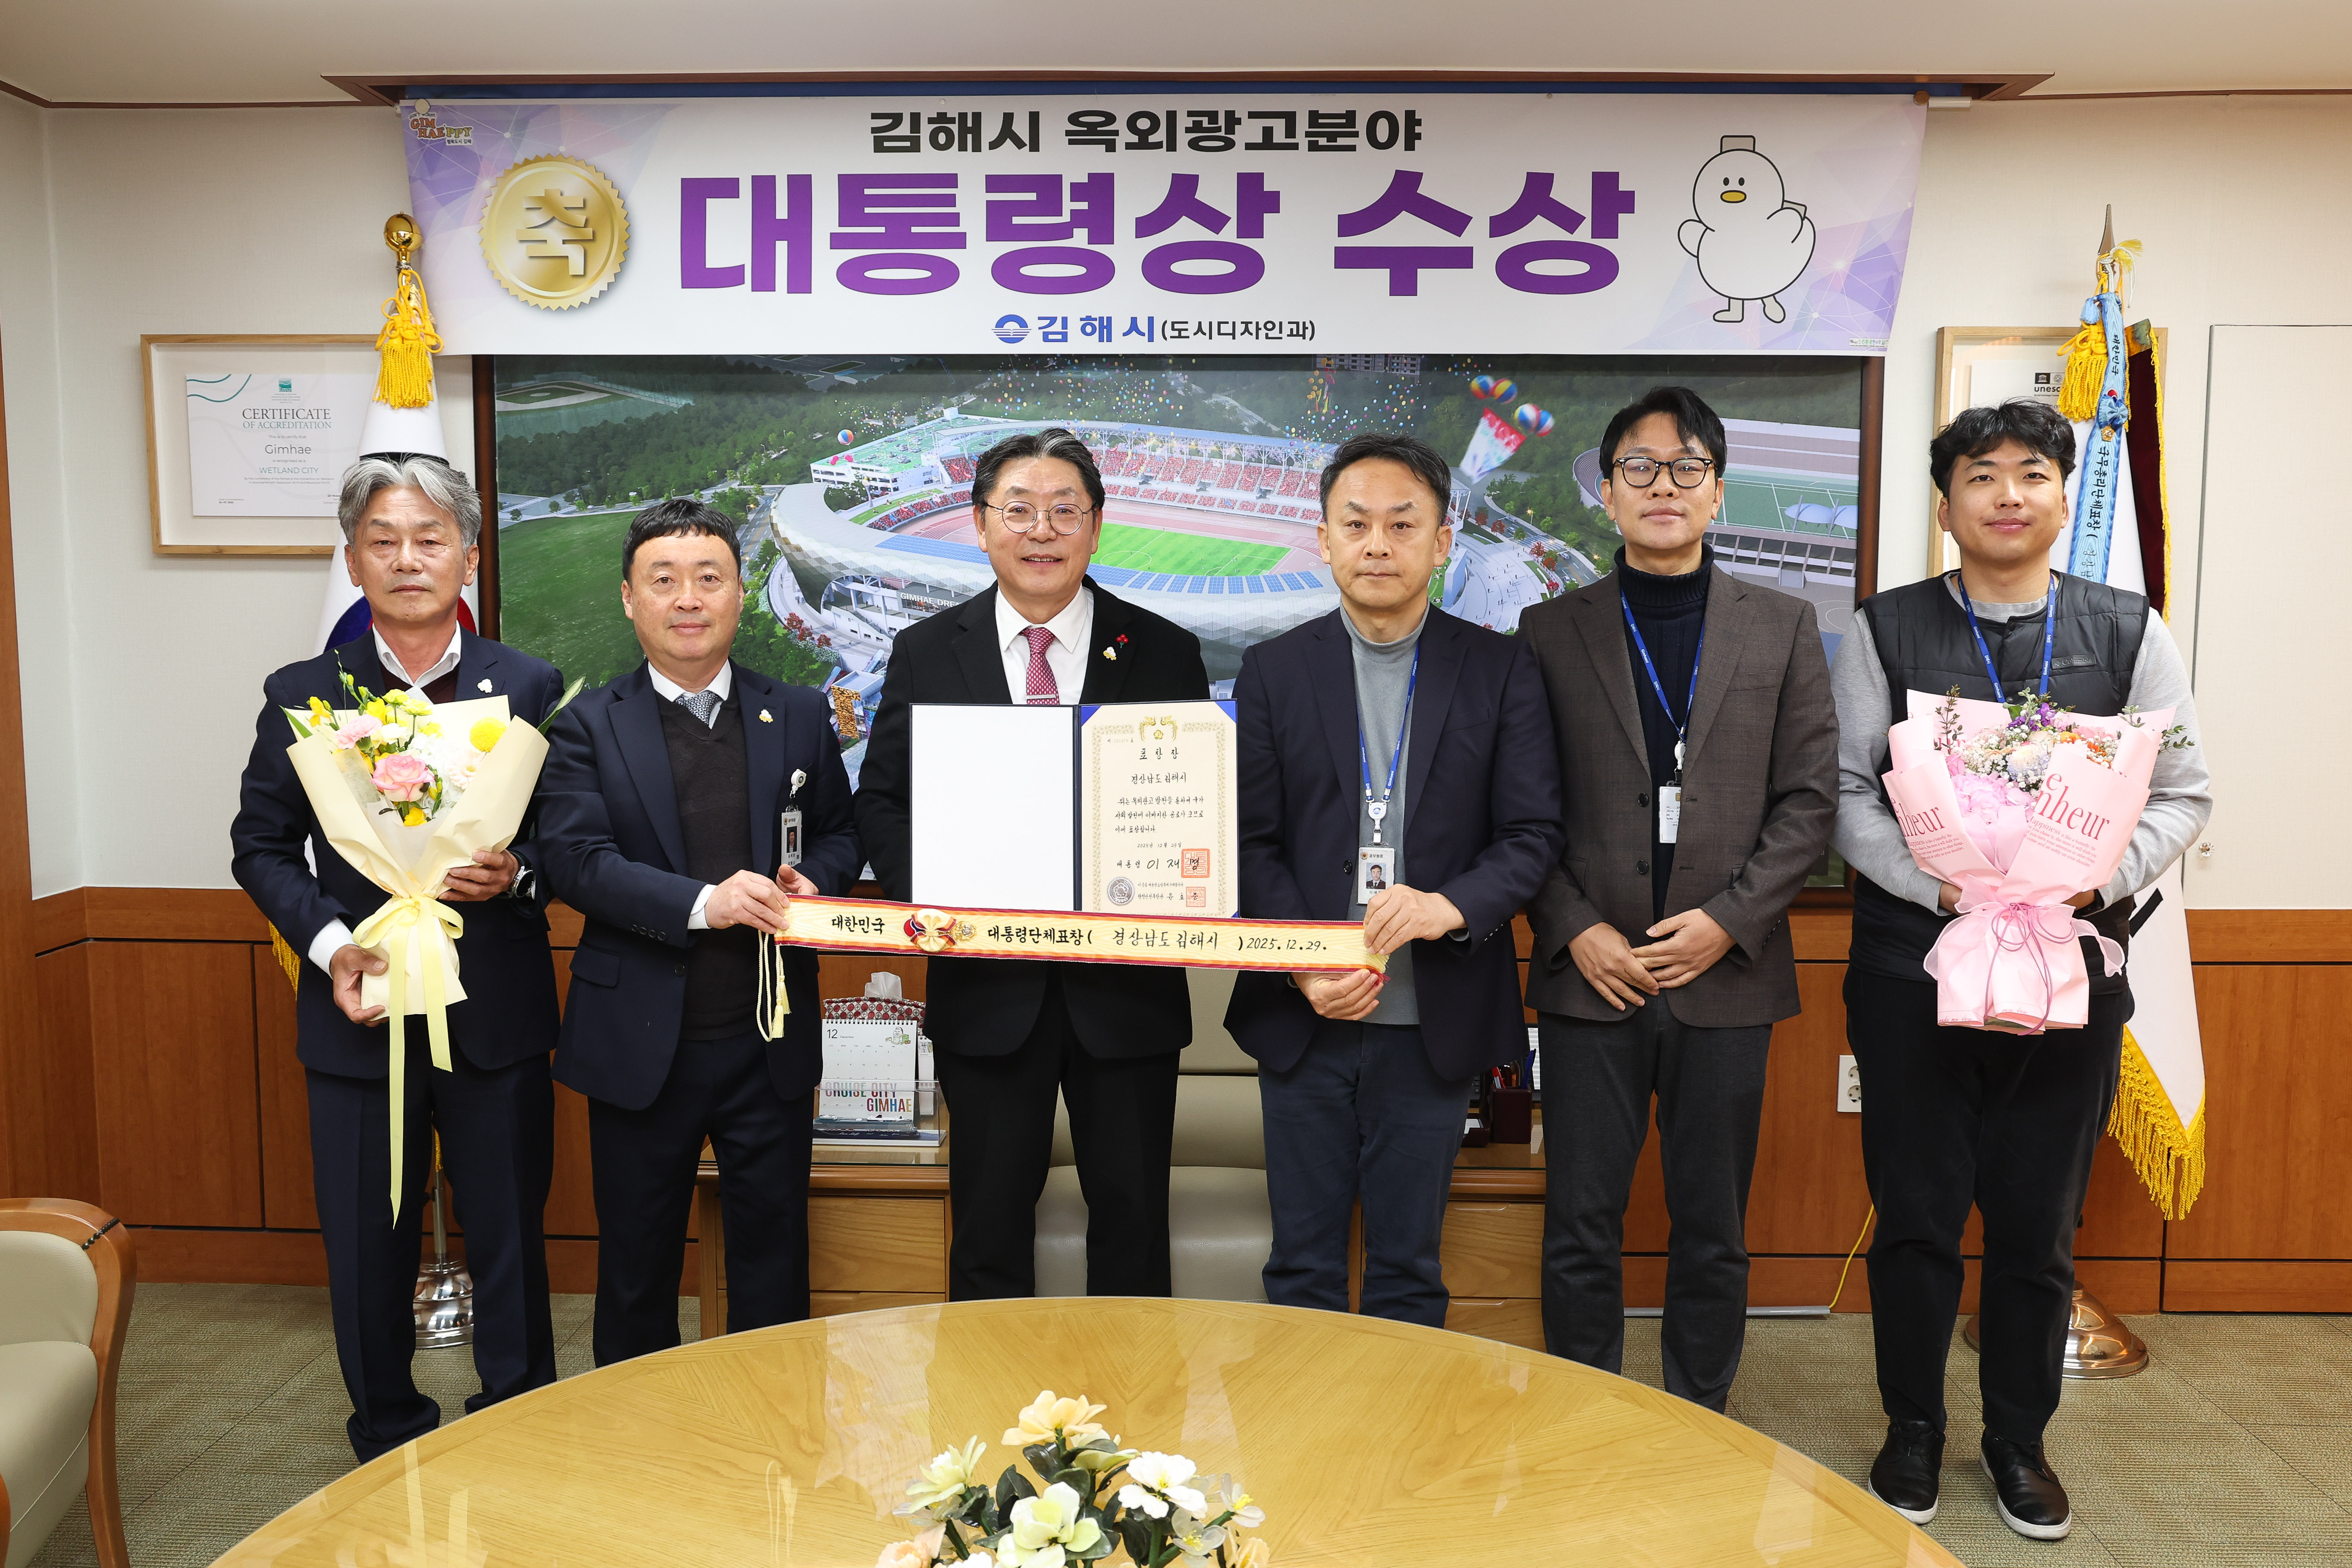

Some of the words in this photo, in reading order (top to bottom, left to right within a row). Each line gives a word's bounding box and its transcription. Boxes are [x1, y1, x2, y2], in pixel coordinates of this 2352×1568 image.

[411, 117, 436, 129] GIM
[871, 111, 1040, 153] 김해시
[1065, 110, 1422, 153] 옥외광고분야
[516, 189, 593, 276] 축
[681, 173, 1279, 295] 대통령상
[1335, 173, 1634, 295] 수상
[1038, 316, 1154, 342] 김해시
[1162, 320, 1315, 341] (도시디자인과)
[2112, 334, 2120, 376] 대한민국
[242, 408, 331, 420] CERTIFICATE
[264, 444, 311, 454] Gimhae
[900, 592, 935, 605] GIMHAE
[1994, 682, 2002, 698] Gimhaesi
[1131, 773, 1162, 785] 경상남도
[1165, 772, 1187, 784] 김해시
[1118, 797, 1130, 806] 위는
[1131, 796, 1154, 806] 옥외광고
[1155, 795, 1173, 805] 발전을
[1174, 796, 1190, 805] 통하여
[1193, 796, 1204, 804] 국가
[1115, 811, 1126, 820] 사회
[1127, 811, 1143, 820] 발전에
[1145, 811, 1167, 820] 이바지한
[1115, 825, 1126, 834] 이에
[832, 914, 886, 935] 대한민국
[987, 924, 1093, 946] 대통령단체표창(
[1112, 927, 1171, 948] 경상남도
[1176, 930, 1218, 951] 김해시
[827, 1029, 838, 1039] 12
[825, 1081, 867, 1097] CRUISE
[871, 1082, 897, 1098] CITY
[867, 1098, 912, 1112] GIMHAE
